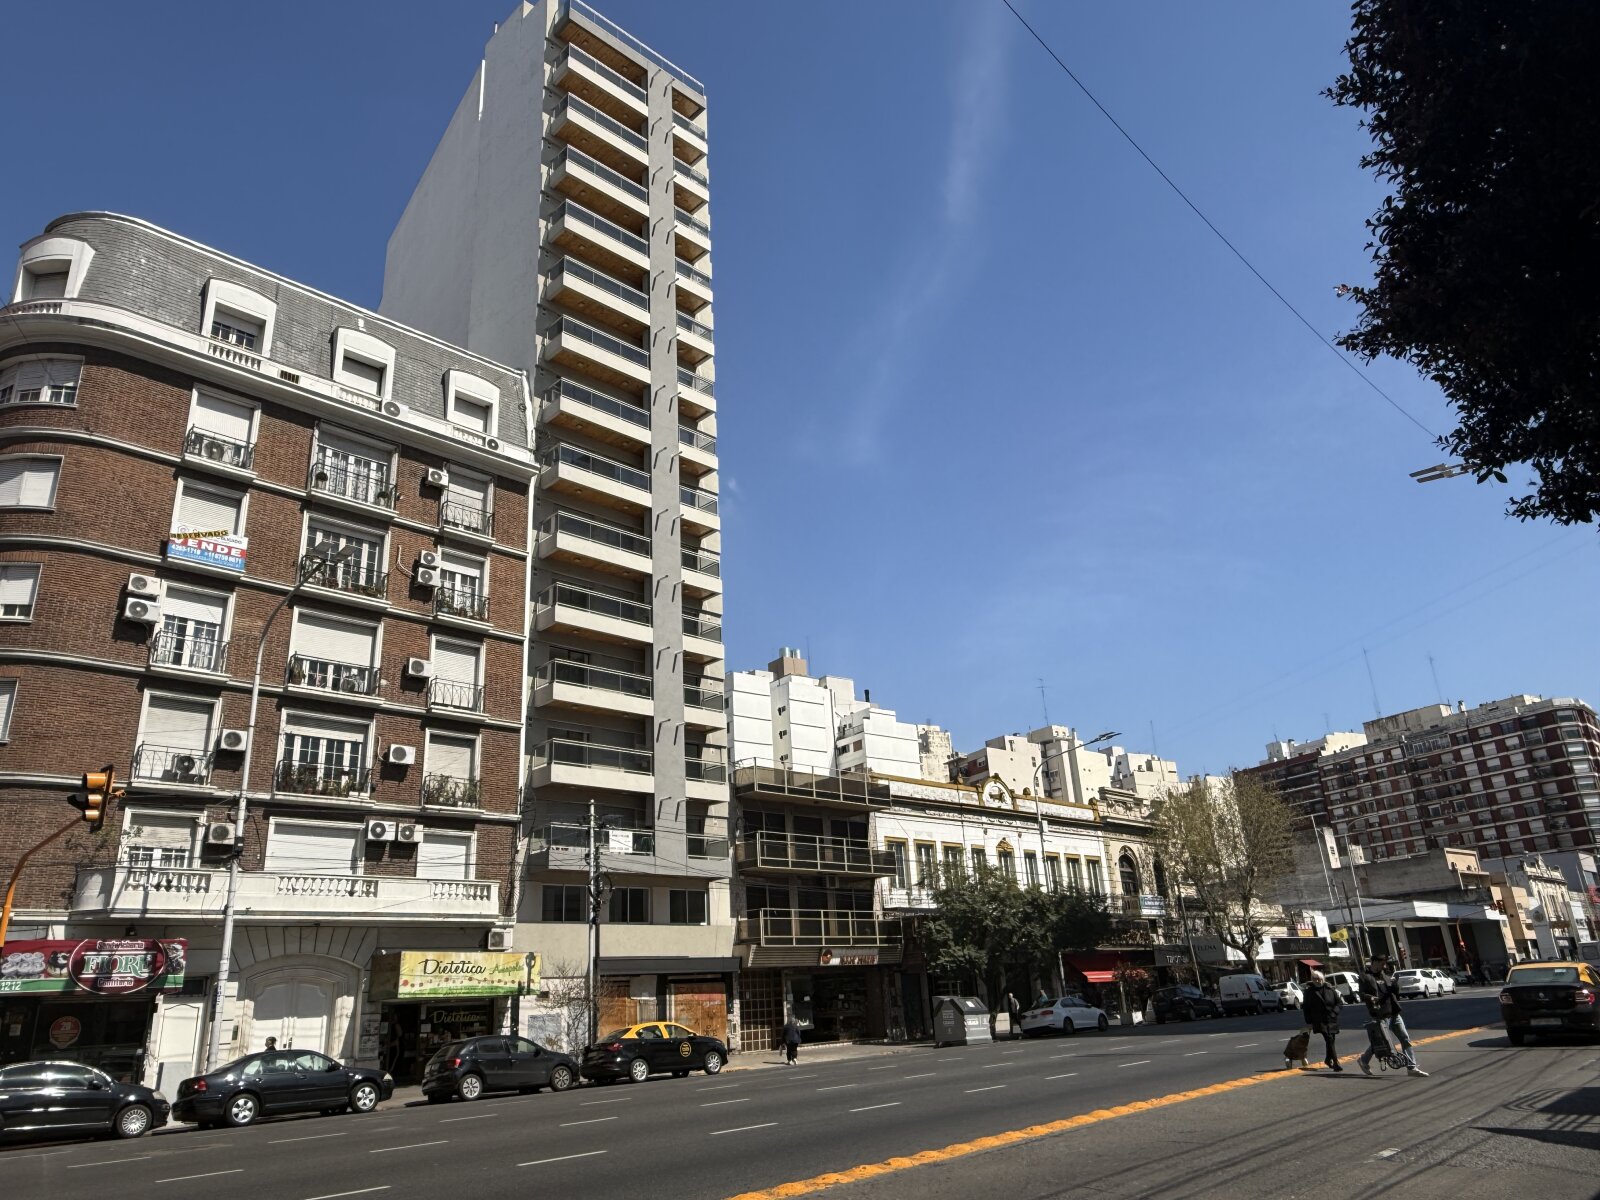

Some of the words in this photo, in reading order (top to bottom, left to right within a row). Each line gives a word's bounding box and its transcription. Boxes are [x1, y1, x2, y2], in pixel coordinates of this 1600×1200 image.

[169, 530, 229, 539] RESERVADO
[174, 539, 242, 557] VENDE
[82, 955, 152, 978] FIORE
[0, 981, 22, 991] 1212
